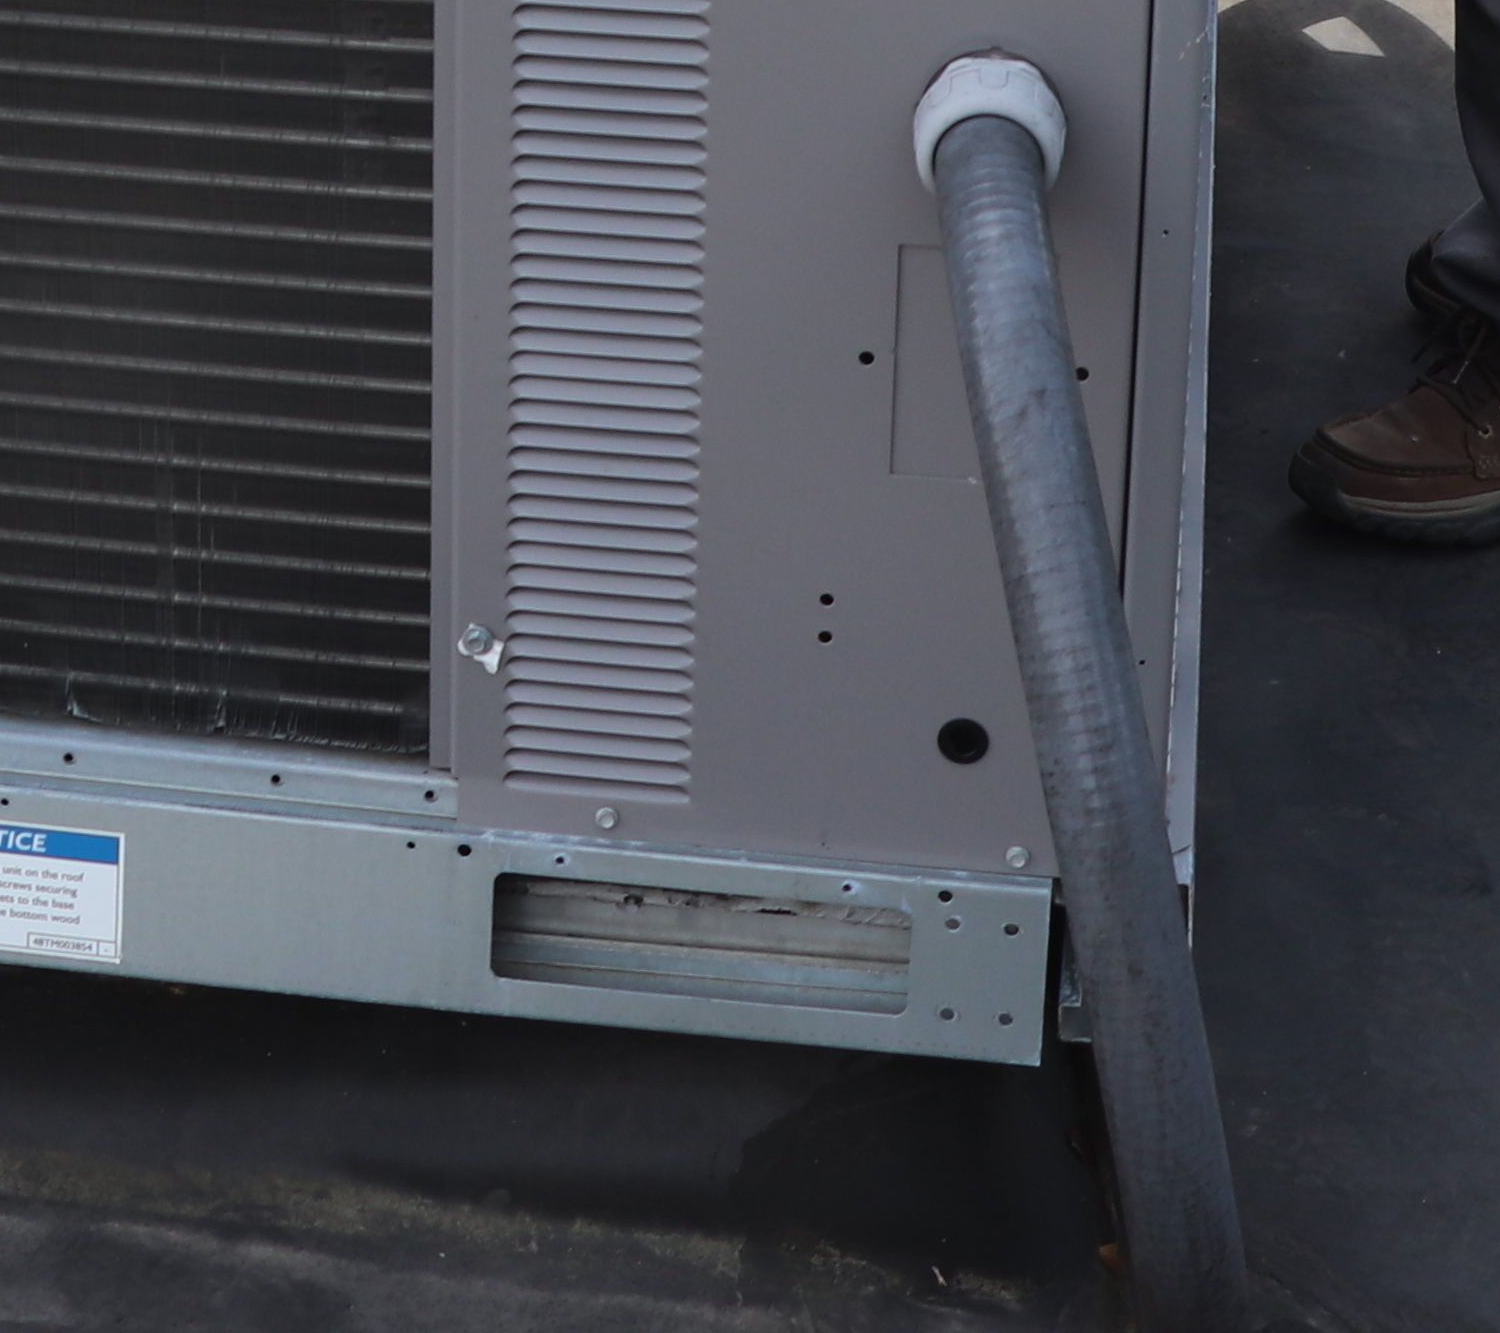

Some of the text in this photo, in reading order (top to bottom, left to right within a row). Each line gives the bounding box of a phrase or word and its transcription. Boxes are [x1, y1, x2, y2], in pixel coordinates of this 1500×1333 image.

[2, 866, 22, 876] unit
[24, 869, 39, 878] on
[41, 868, 58, 880] the
[61, 872, 85, 883] roof
[35, 884, 78, 899] securing
[17, 895, 29, 905] to
[32, 896, 49, 907] the
[51, 898, 75, 910] base
[9, 908, 48, 921] bottom
[51, 914, 80, 925] wood
